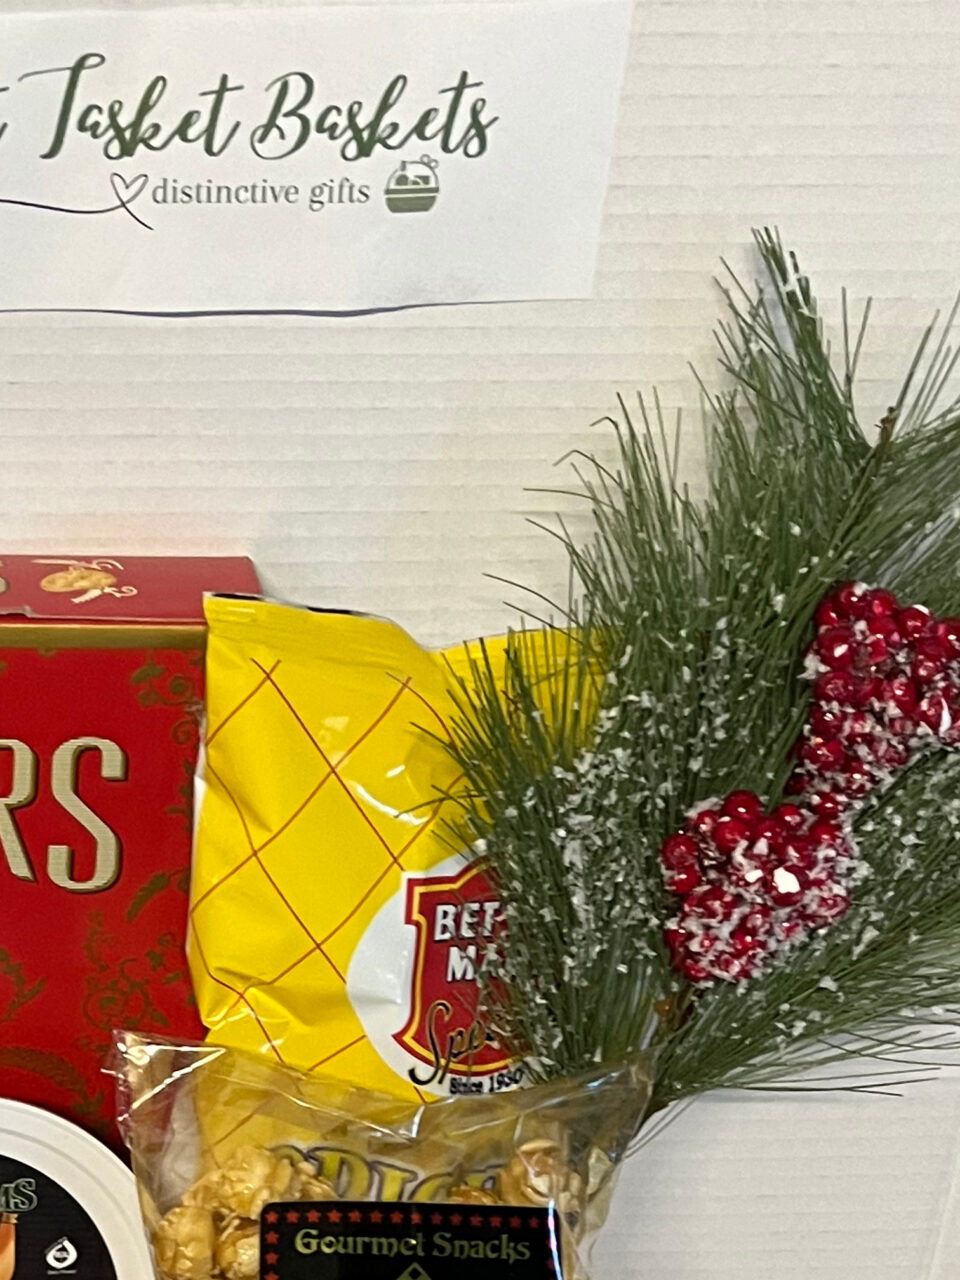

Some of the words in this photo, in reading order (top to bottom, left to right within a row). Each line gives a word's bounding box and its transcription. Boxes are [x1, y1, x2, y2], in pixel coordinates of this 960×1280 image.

[19, 52, 242, 161] Tasket
[249, 69, 499, 161] Baskets
[152, 178, 300, 206] distinctive
[309, 177, 371, 213] gifts
[434, 902, 502, 942] BET
[295, 1228, 425, 1257] Gourmet
[432, 1231, 530, 1264] Snacks
